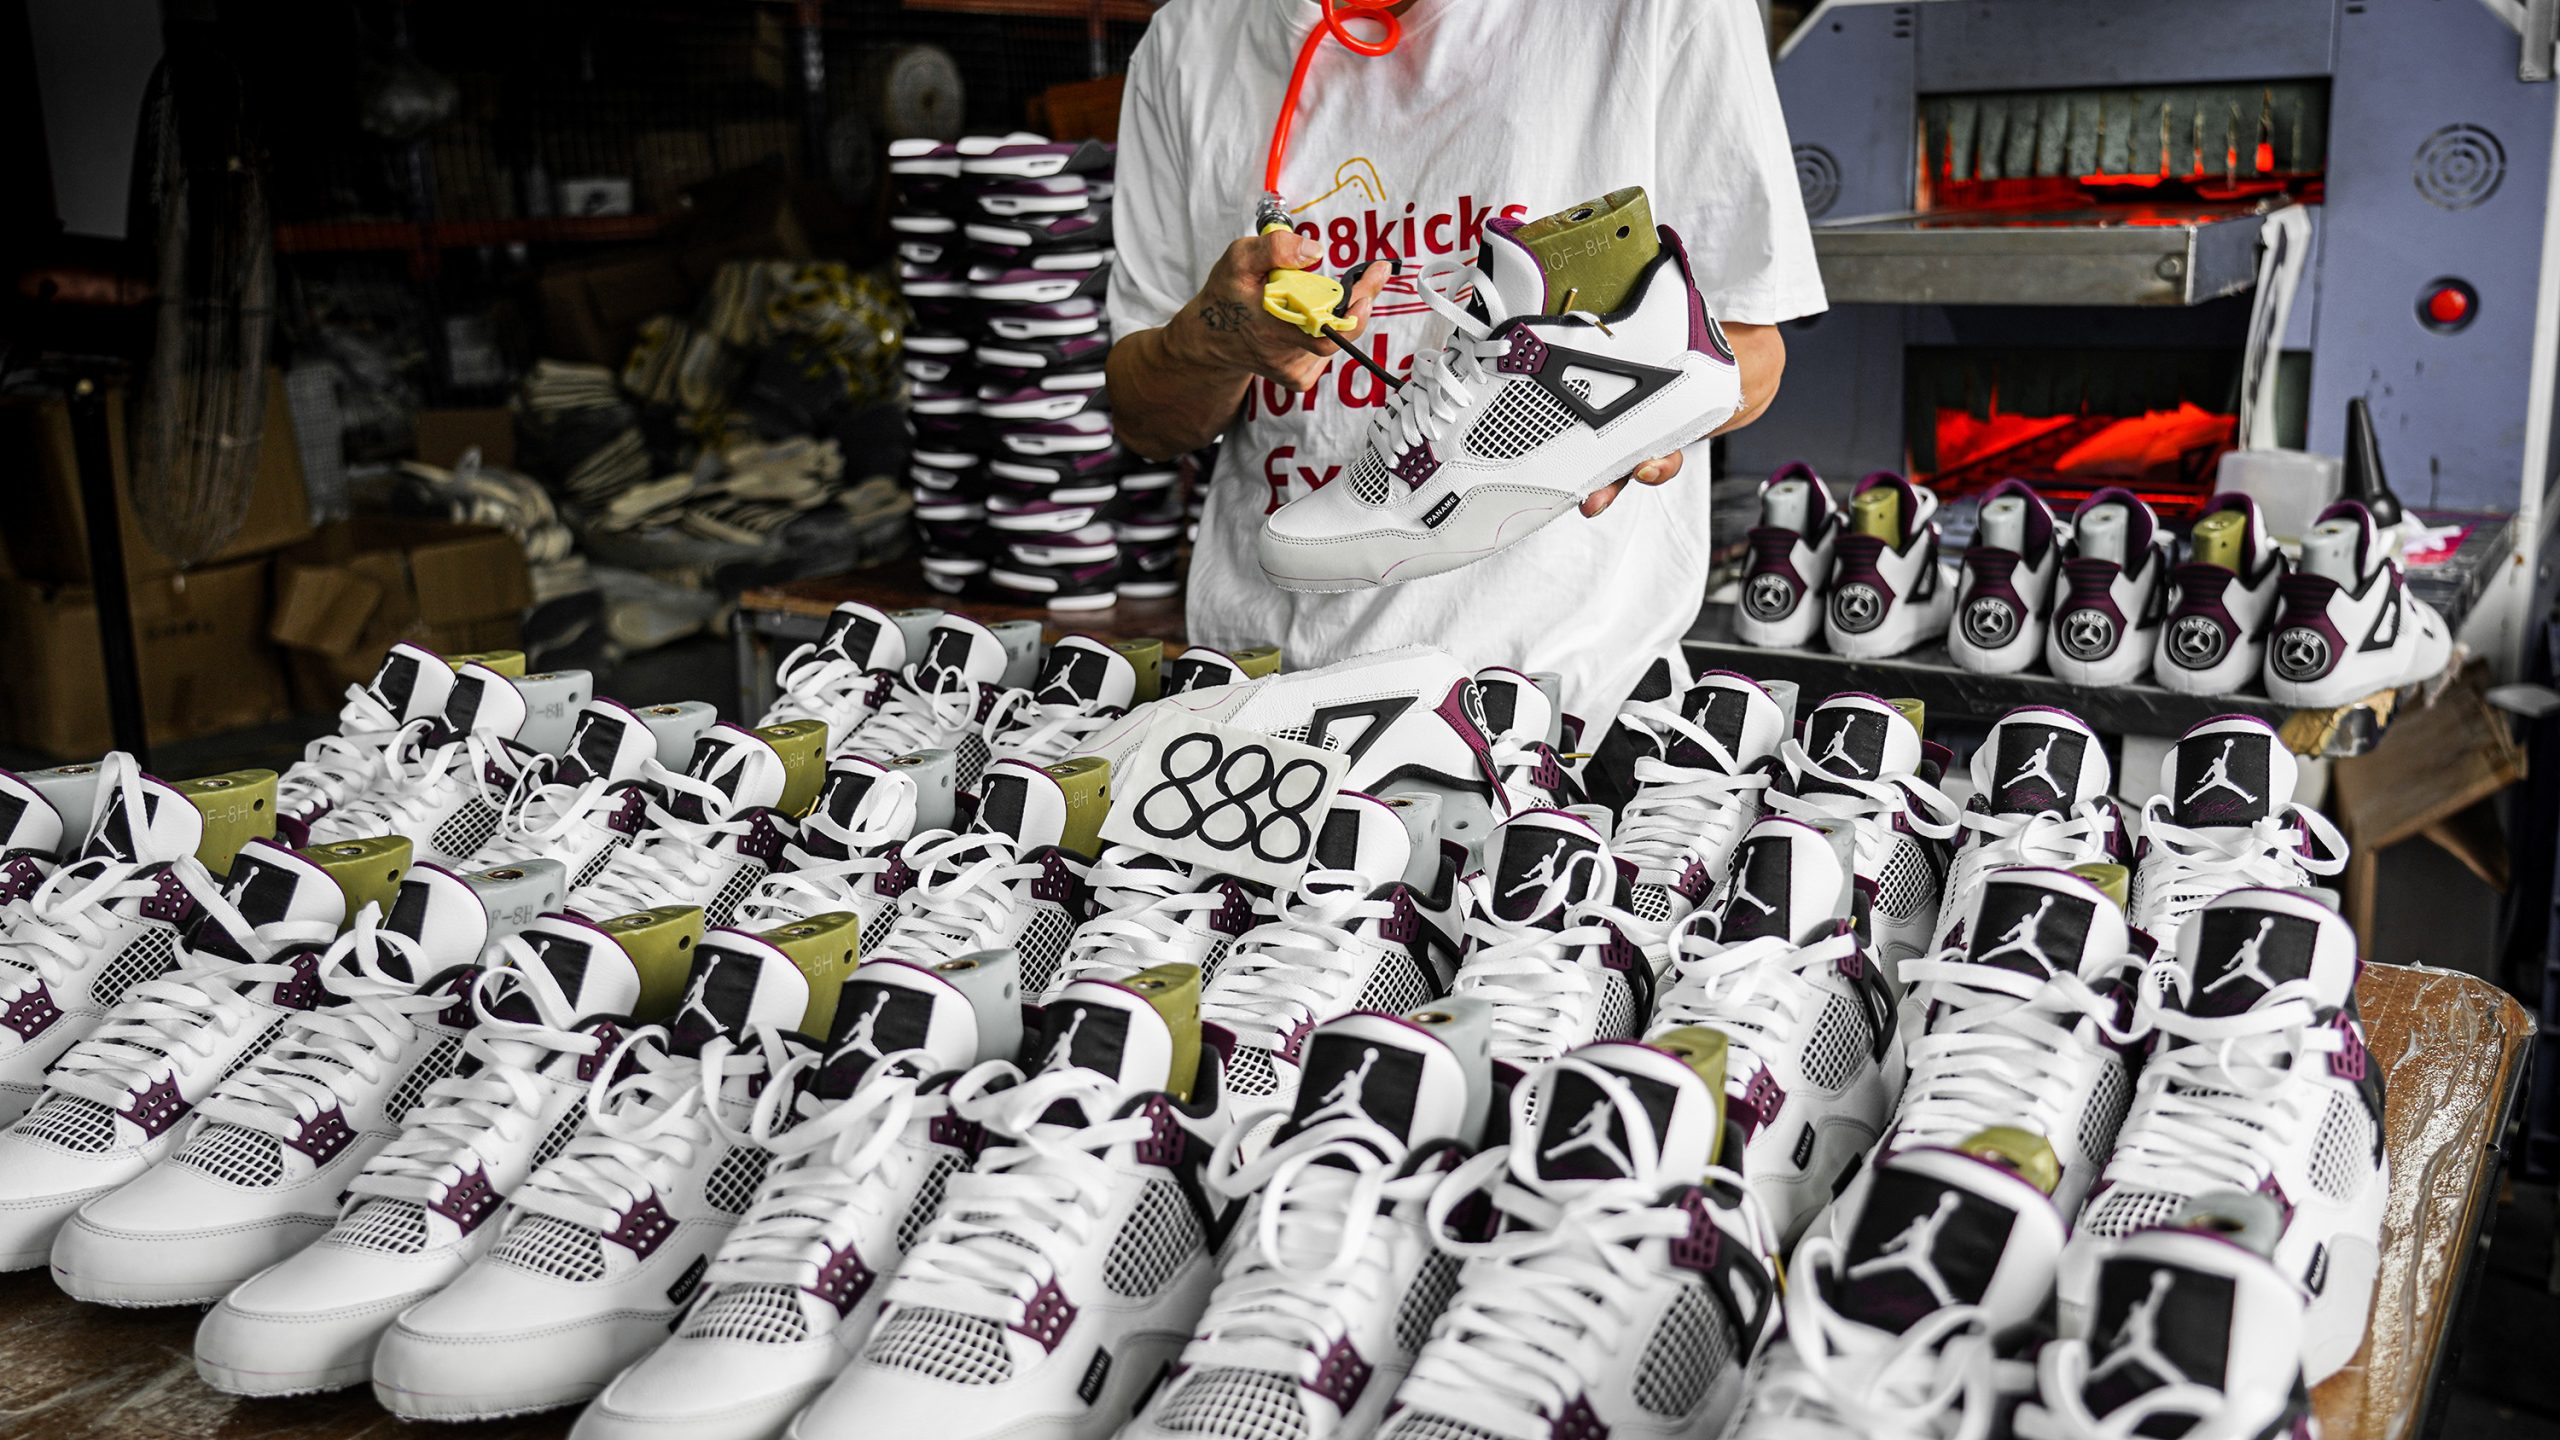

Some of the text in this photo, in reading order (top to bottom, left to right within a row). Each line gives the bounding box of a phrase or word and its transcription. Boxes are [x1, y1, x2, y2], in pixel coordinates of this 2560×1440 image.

[1544, 234, 1611, 275] JQF-8H
[1426, 495, 1457, 526] PANAME
[1973, 601, 2008, 616] PARIS
[2070, 612, 2106, 628] PARIS
[2179, 619, 2217, 636] PARIS
[2283, 631, 2321, 647] PARIS
[1132, 732, 1328, 864] 888
[797, 951, 833, 977] -8H
